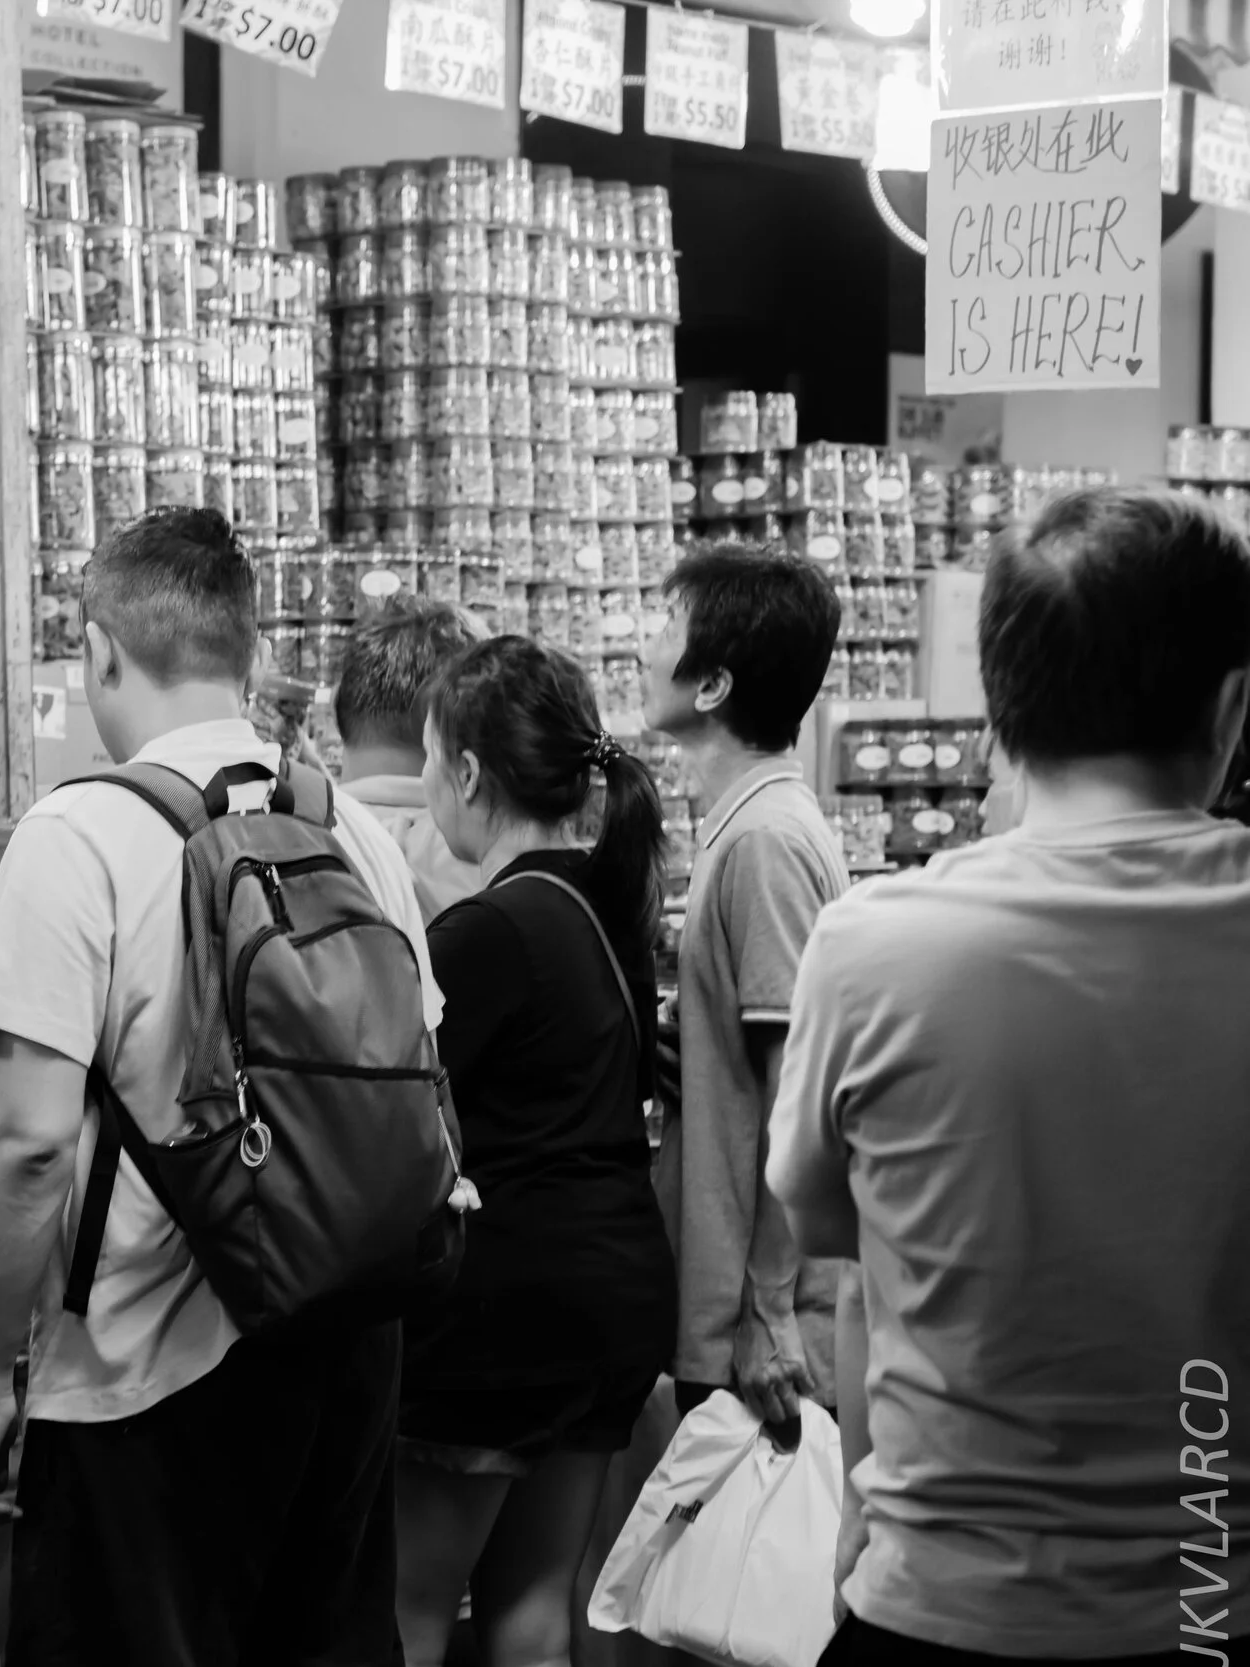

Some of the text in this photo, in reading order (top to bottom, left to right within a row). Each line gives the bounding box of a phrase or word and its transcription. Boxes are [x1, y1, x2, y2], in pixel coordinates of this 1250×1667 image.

[30, 22, 101, 48] HOTEL
[236, 6, 316, 60] $7.00
[438, 54, 499, 96] $7.00
[561, 78, 615, 118] $7.00
[685, 97, 739, 132] $5.50
[945, 108, 1130, 190] 收银处在此
[949, 196, 1145, 279] CASHIER
[949, 292, 1144, 377] IS HERE!
